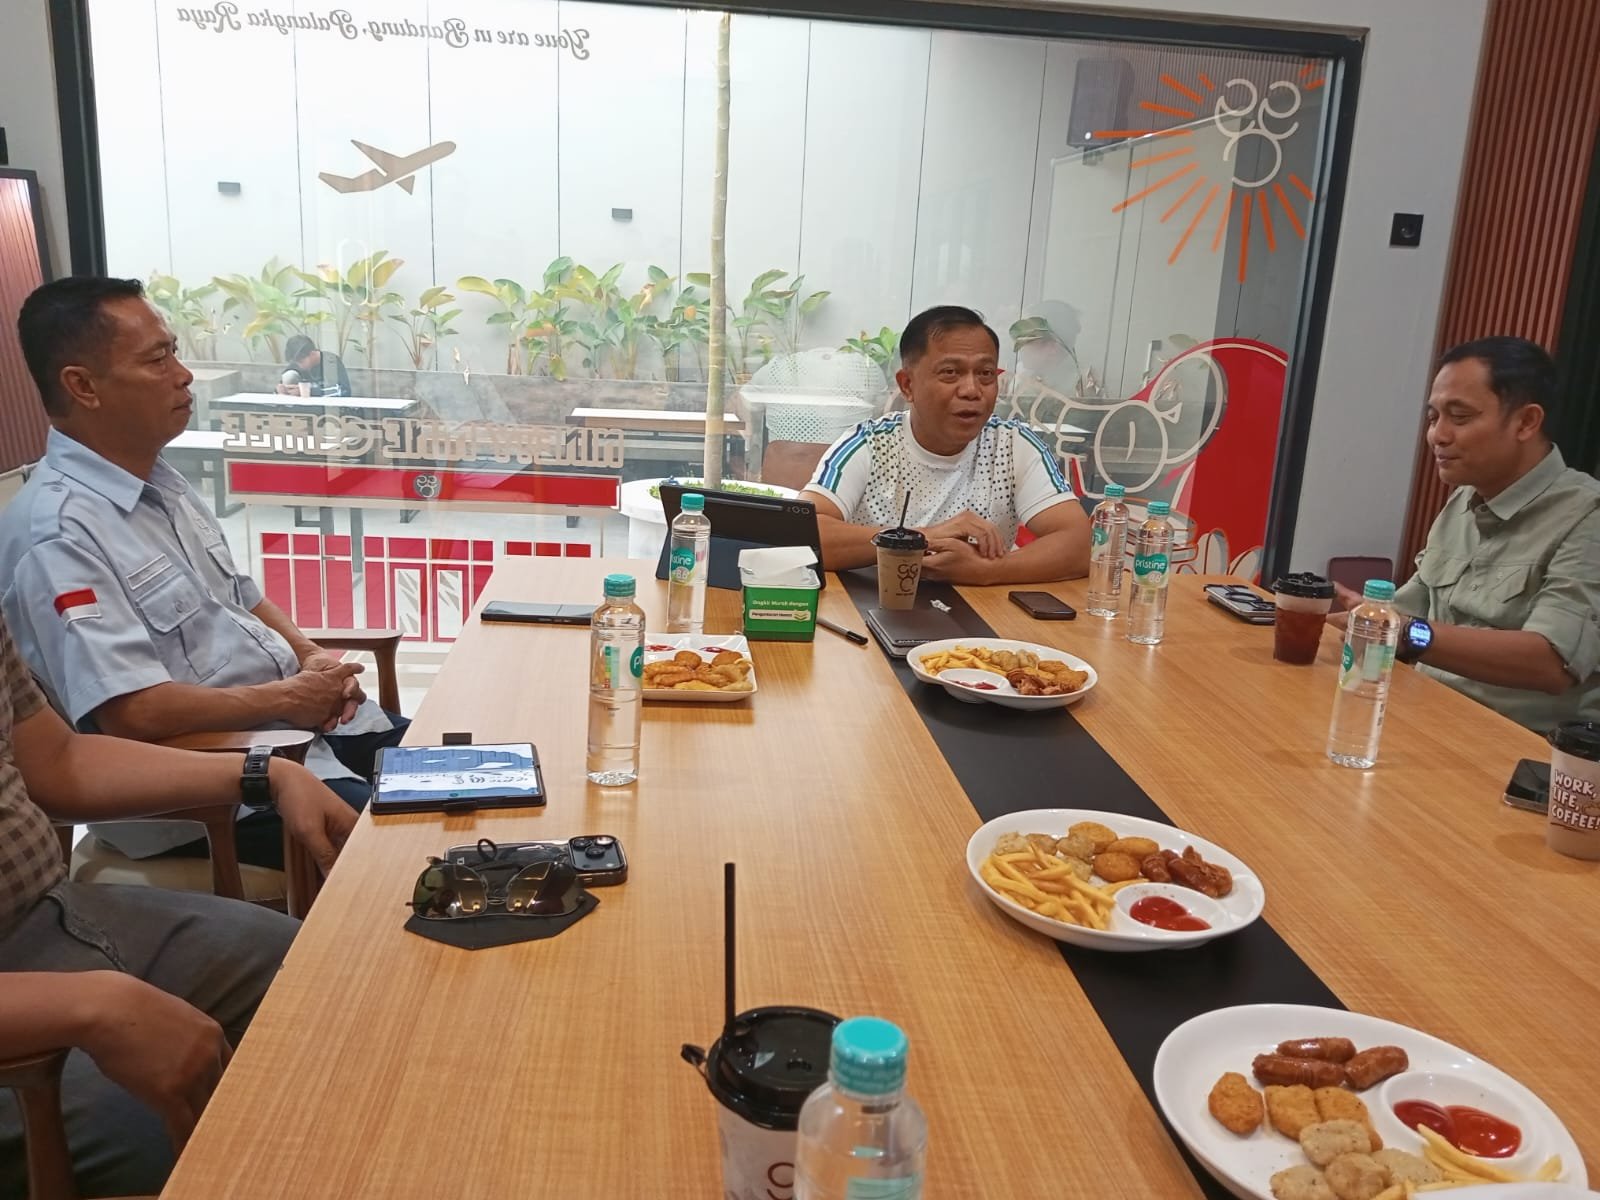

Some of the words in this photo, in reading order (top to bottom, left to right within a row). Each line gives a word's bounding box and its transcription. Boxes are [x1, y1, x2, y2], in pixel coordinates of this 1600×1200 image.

[1135, 559, 1165, 569] pristine
[1554, 769, 1597, 798] WORK,
[1552, 786, 1580, 811] LIFE,
